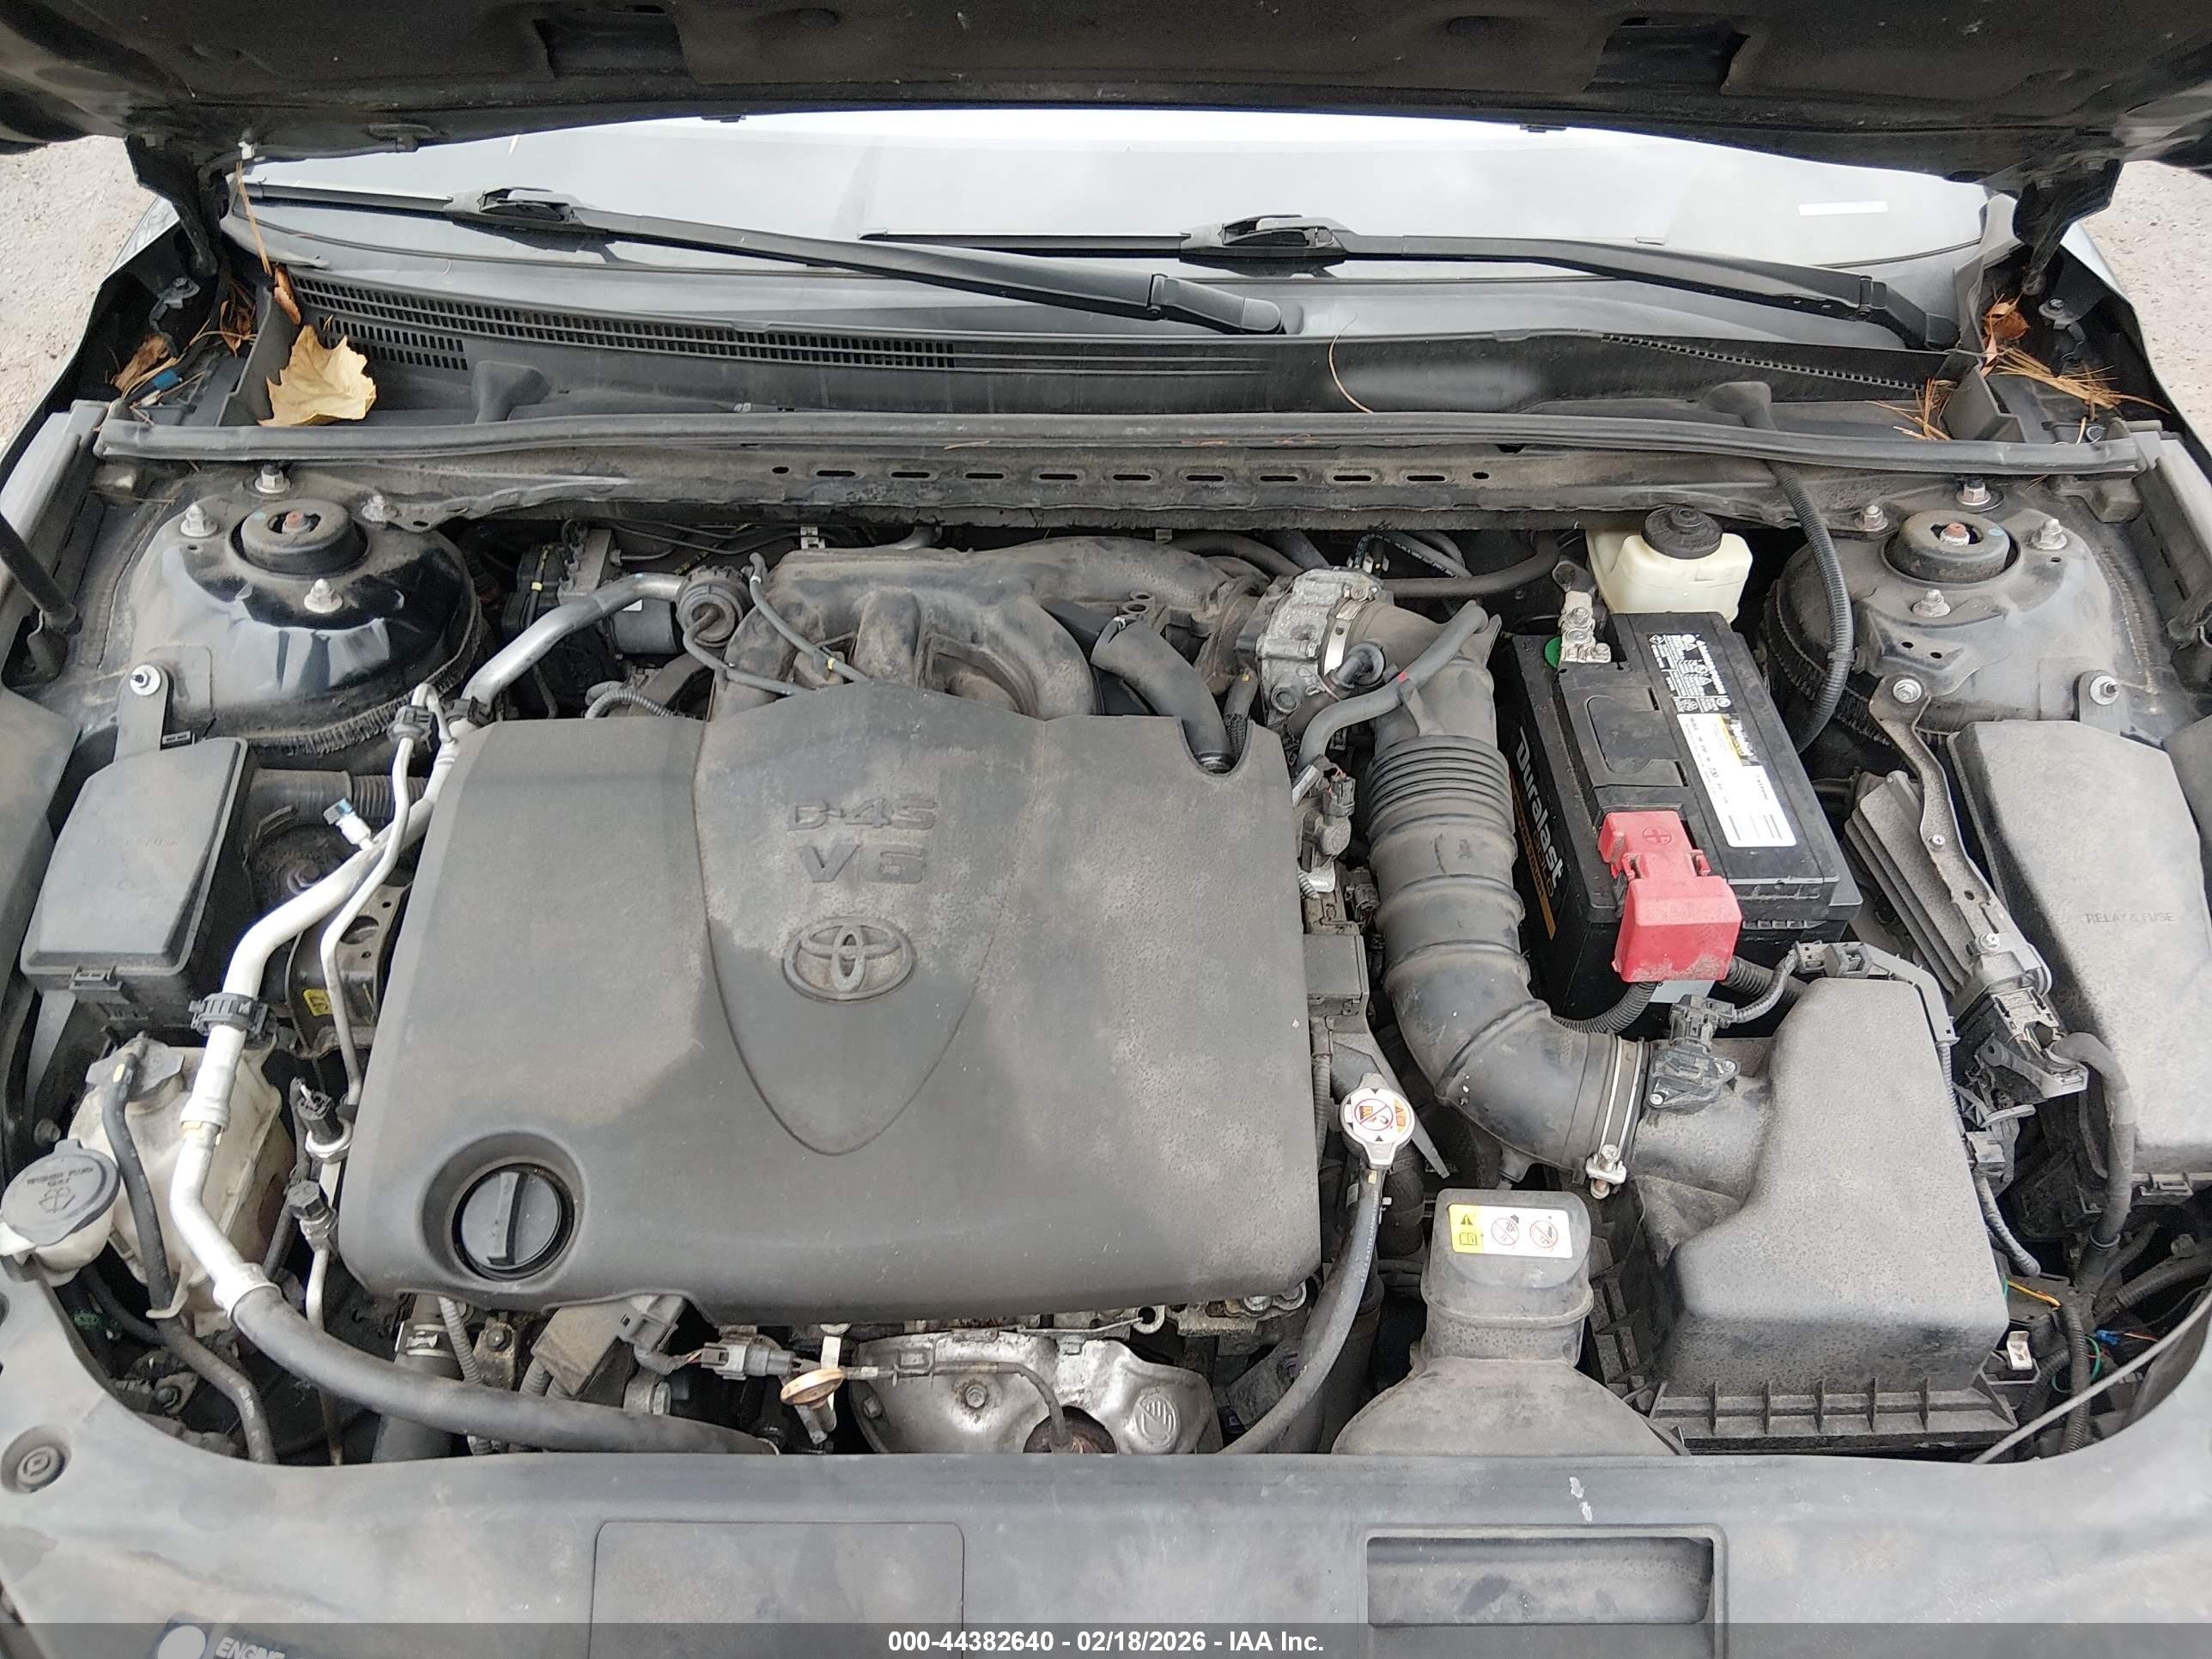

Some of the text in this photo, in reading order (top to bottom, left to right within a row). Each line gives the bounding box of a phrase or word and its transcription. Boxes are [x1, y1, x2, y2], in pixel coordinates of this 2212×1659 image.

[787, 797, 938, 830] D-4S
[1516, 726, 1564, 890] Duralast
[798, 842, 926, 884] V6
[1533, 830, 1554, 898] GOLD
[2084, 913, 2125, 923] RELAY
[2142, 912, 2176, 921] FUSE
